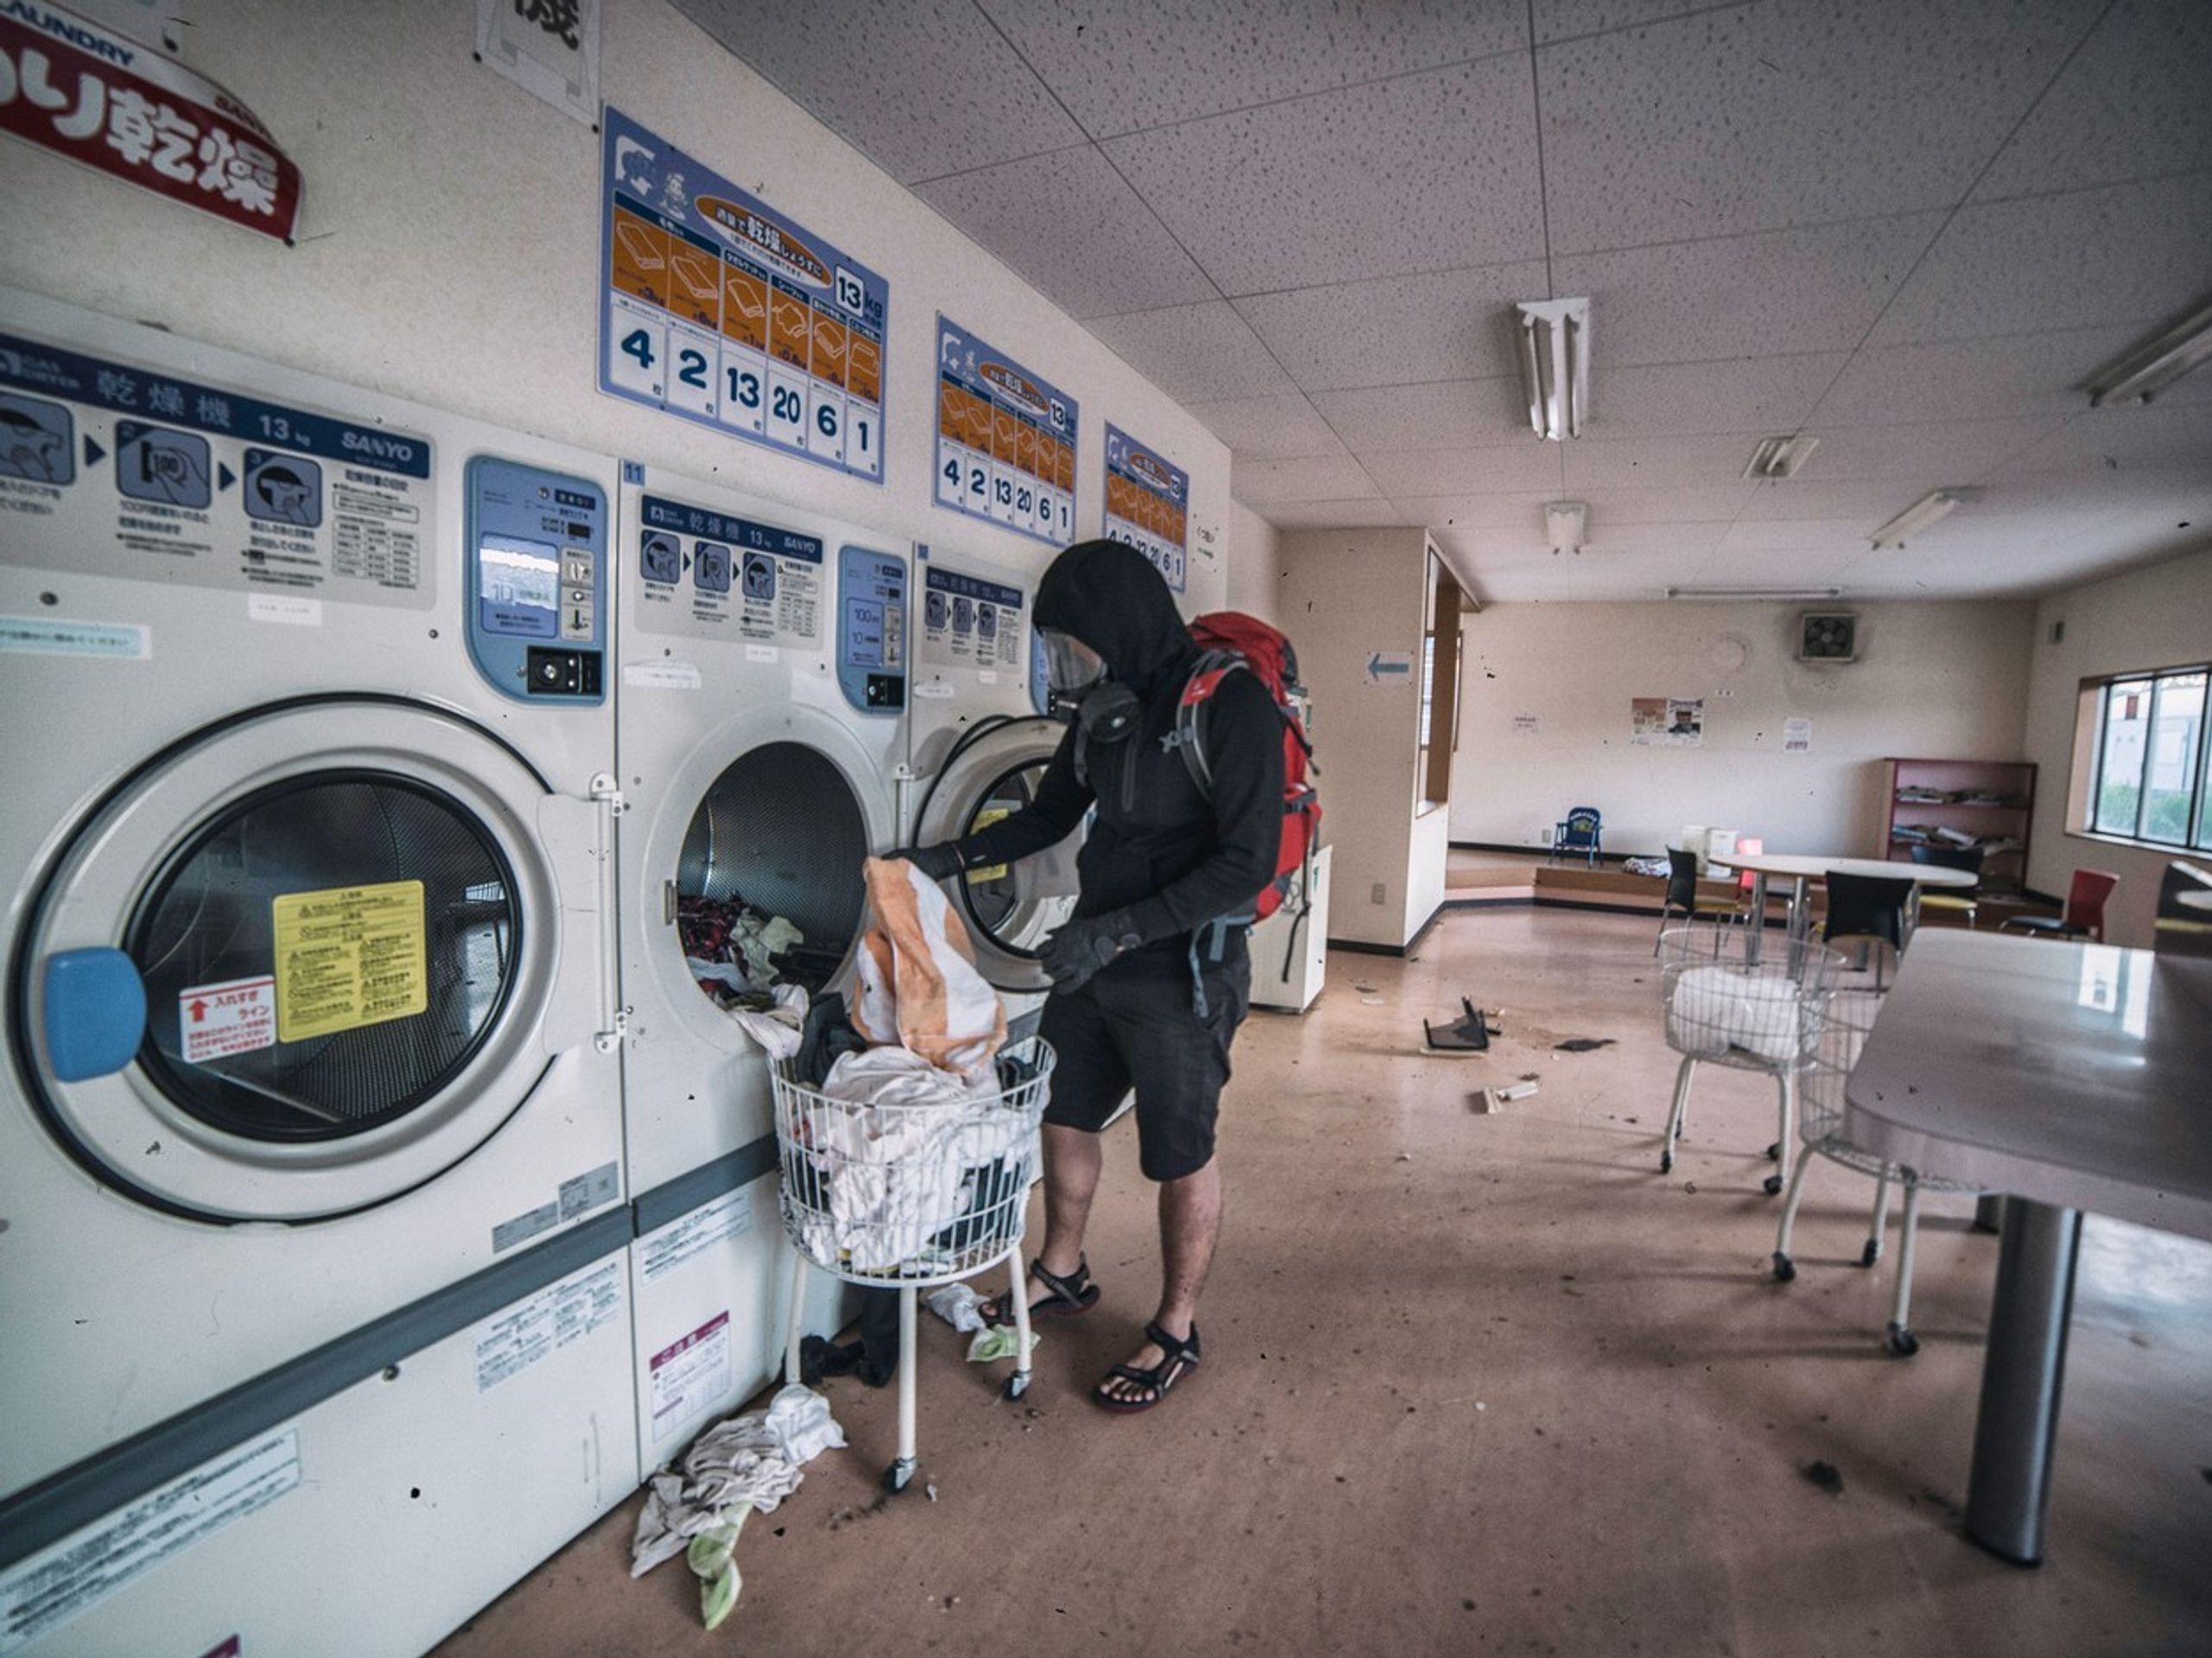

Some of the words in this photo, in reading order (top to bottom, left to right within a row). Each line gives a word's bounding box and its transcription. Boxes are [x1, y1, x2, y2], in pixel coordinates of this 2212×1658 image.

[838, 275, 862, 310] 13
[621, 328, 656, 370] 4
[679, 349, 708, 390] 2
[726, 367, 760, 409] 13
[96, 369, 231, 428] 乾燥機
[260, 414, 290, 441] 13
[341, 431, 414, 462] SANYO
[773, 385, 802, 424] 20
[1051, 402, 1064, 427] 13
[817, 404, 838, 437] 6
[858, 421, 869, 452] 1
[623, 463, 642, 483] 11
[943, 459, 960, 486] 4
[971, 469, 986, 495] 2
[995, 478, 1012, 505] 13
[1017, 487, 1031, 514] 20
[1039, 497, 1050, 521] 6
[1061, 506, 1068, 528] 1
[750, 529, 764, 546] 13
[783, 535, 816, 554] SANYO
[1163, 554, 1170, 571] 6
[1176, 558, 1181, 576] 1
